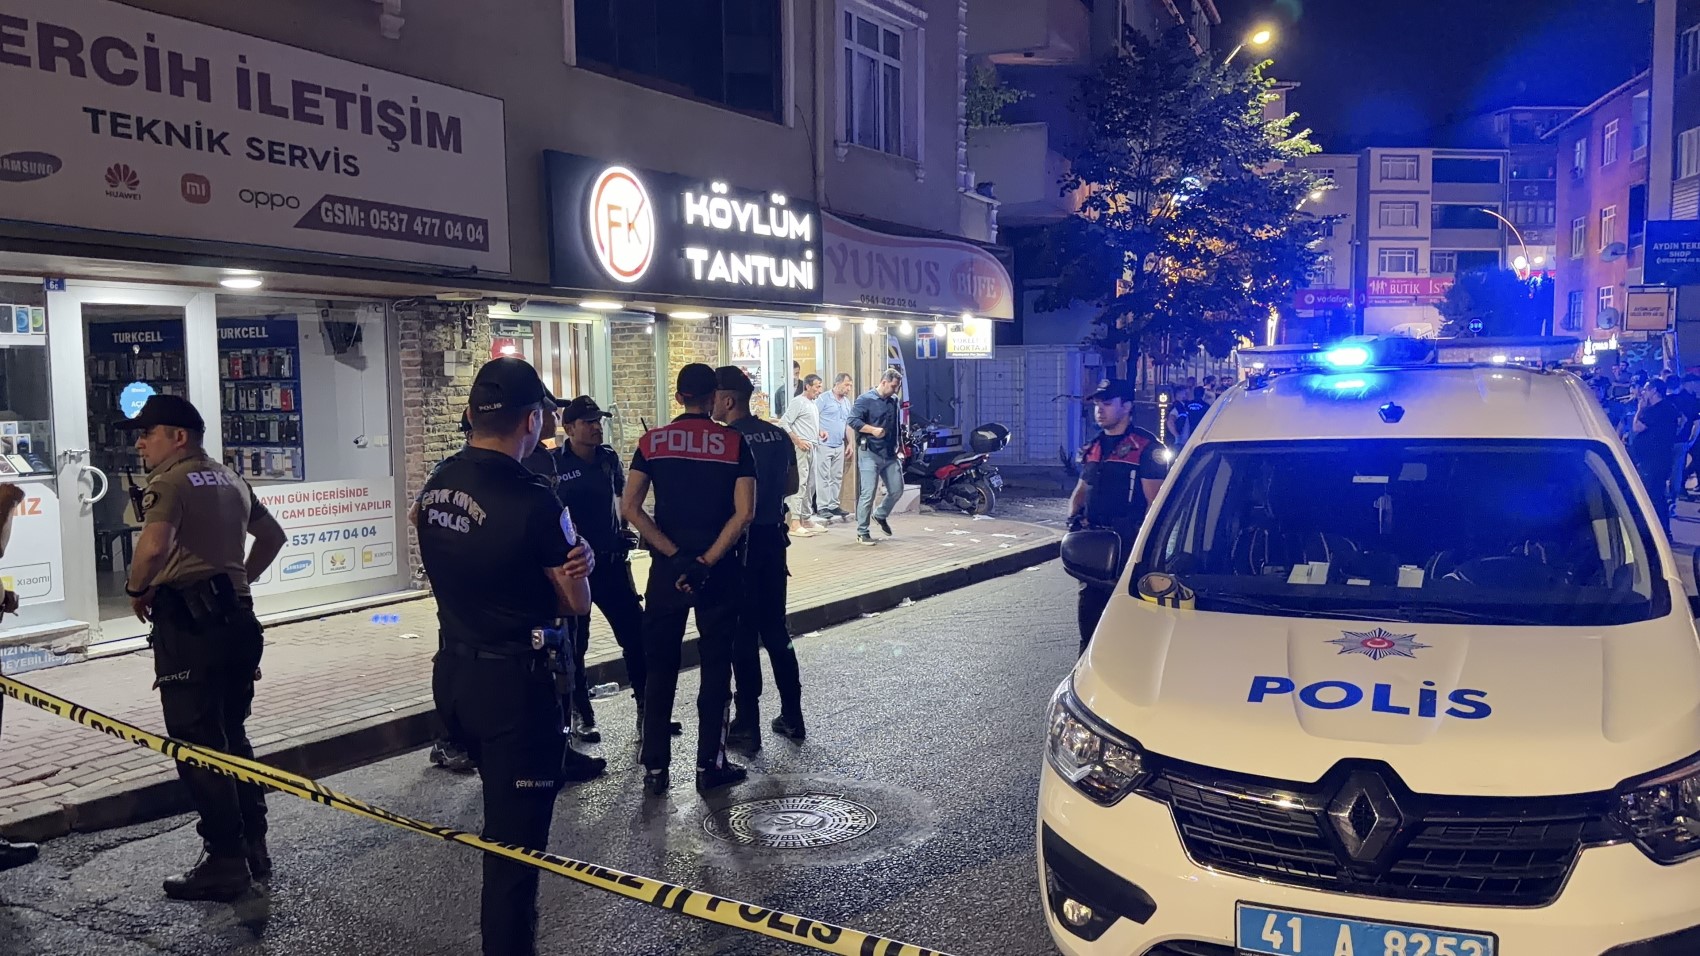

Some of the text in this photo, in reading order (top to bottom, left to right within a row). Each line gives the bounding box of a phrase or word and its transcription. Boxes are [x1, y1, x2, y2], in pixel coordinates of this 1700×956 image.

[0, 14, 463, 154] ERCİH İLETİŞİM
[82, 107, 361, 177] TEKNİK SERVİS
[0, 158, 53, 176] AMSUNG
[105, 189, 142, 201] HUAWEI
[239, 188, 300, 211] oppo
[684, 181, 812, 242] KÖYLÜM
[320, 201, 484, 244] GSM: 0537 477 04 04
[1669, 250, 1691, 258] SHOP
[686, 247, 814, 290] TANTUNİ
[825, 242, 997, 299] YUNUS BÜFE
[1390, 281, 1420, 294] BUTİK
[882, 297, 896, 307] 422
[908, 300, 917, 308] 04
[112, 331, 163, 344] TURKCELL
[649, 429, 725, 455] POLİS
[260, 487, 369, 506] AYNI GÜN İÇERİSİNDE
[281, 508, 305, 520] CAM
[307, 501, 354, 517] DEĞİŞİMİ
[354, 500, 391, 511] YAPILIR
[318, 530, 340, 543] 477
[343, 527, 359, 540] 04
[361, 526, 377, 537] 04
[17, 575, 50, 587] xiaomi
[1247, 675, 1493, 720] POLİS
[1261, 913, 1302, 953] 41
[1333, 923, 1354, 956] A
